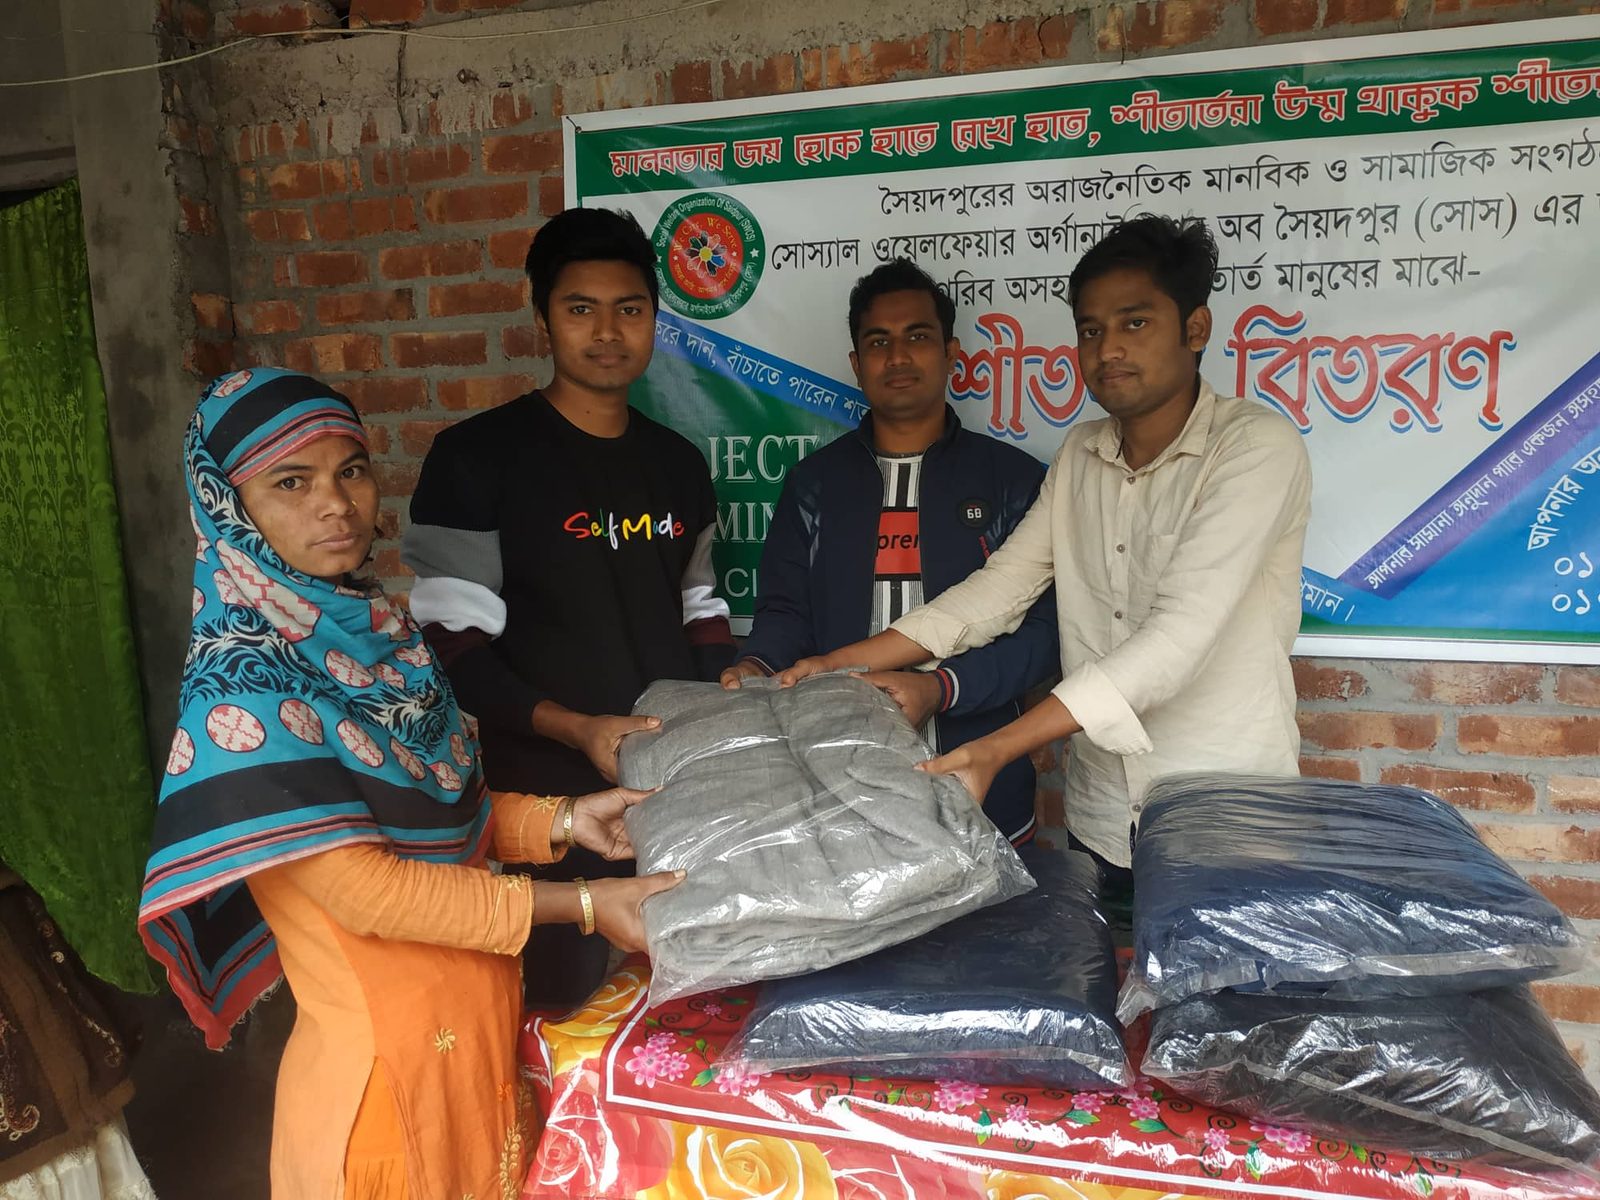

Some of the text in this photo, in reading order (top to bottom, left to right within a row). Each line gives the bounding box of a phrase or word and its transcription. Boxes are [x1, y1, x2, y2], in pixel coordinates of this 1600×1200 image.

[609, 141, 725, 178] মানবতার
[733, 136, 783, 168] জয়
[793, 128, 862, 166] হোক
[870, 121, 941, 156] হাতে
[951, 115, 1015, 152] রেখে
[1110, 90, 1264, 134] শীতার্তরা
[1357, 76, 1481, 123] থাকুক
[1491, 58, 1600, 104] শীতে
[878, 127, 1600, 217] সৈয়দপুরের অরাজনৈতিক মানবিক ও সামাজিক সংগঠ
[771, 236, 860, 271] সোস্যাল
[1217, 211, 1265, 244] অব
[1274, 202, 1400, 245] সৈয়দপুর
[1414, 191, 1518, 242] (সোস)
[1534, 193, 1584, 227] এর
[1004, 274, 1073, 307] অসহ
[1211, 252, 1267, 295] তার্ত
[1275, 257, 1381, 299] মানুষের
[726, 345, 783, 386] বাঁচাতে
[788, 375, 839, 412] পারেন
[1224, 304, 1518, 435] বিতরণ
[1363, 544, 1414, 589] আপনার
[1448, 473, 1498, 517] অনুদান
[1492, 450, 1525, 479] পারে
[1521, 411, 1570, 456] একজন
[1563, 377, 1600, 420] অসহ
[562, 508, 619, 551] Self
